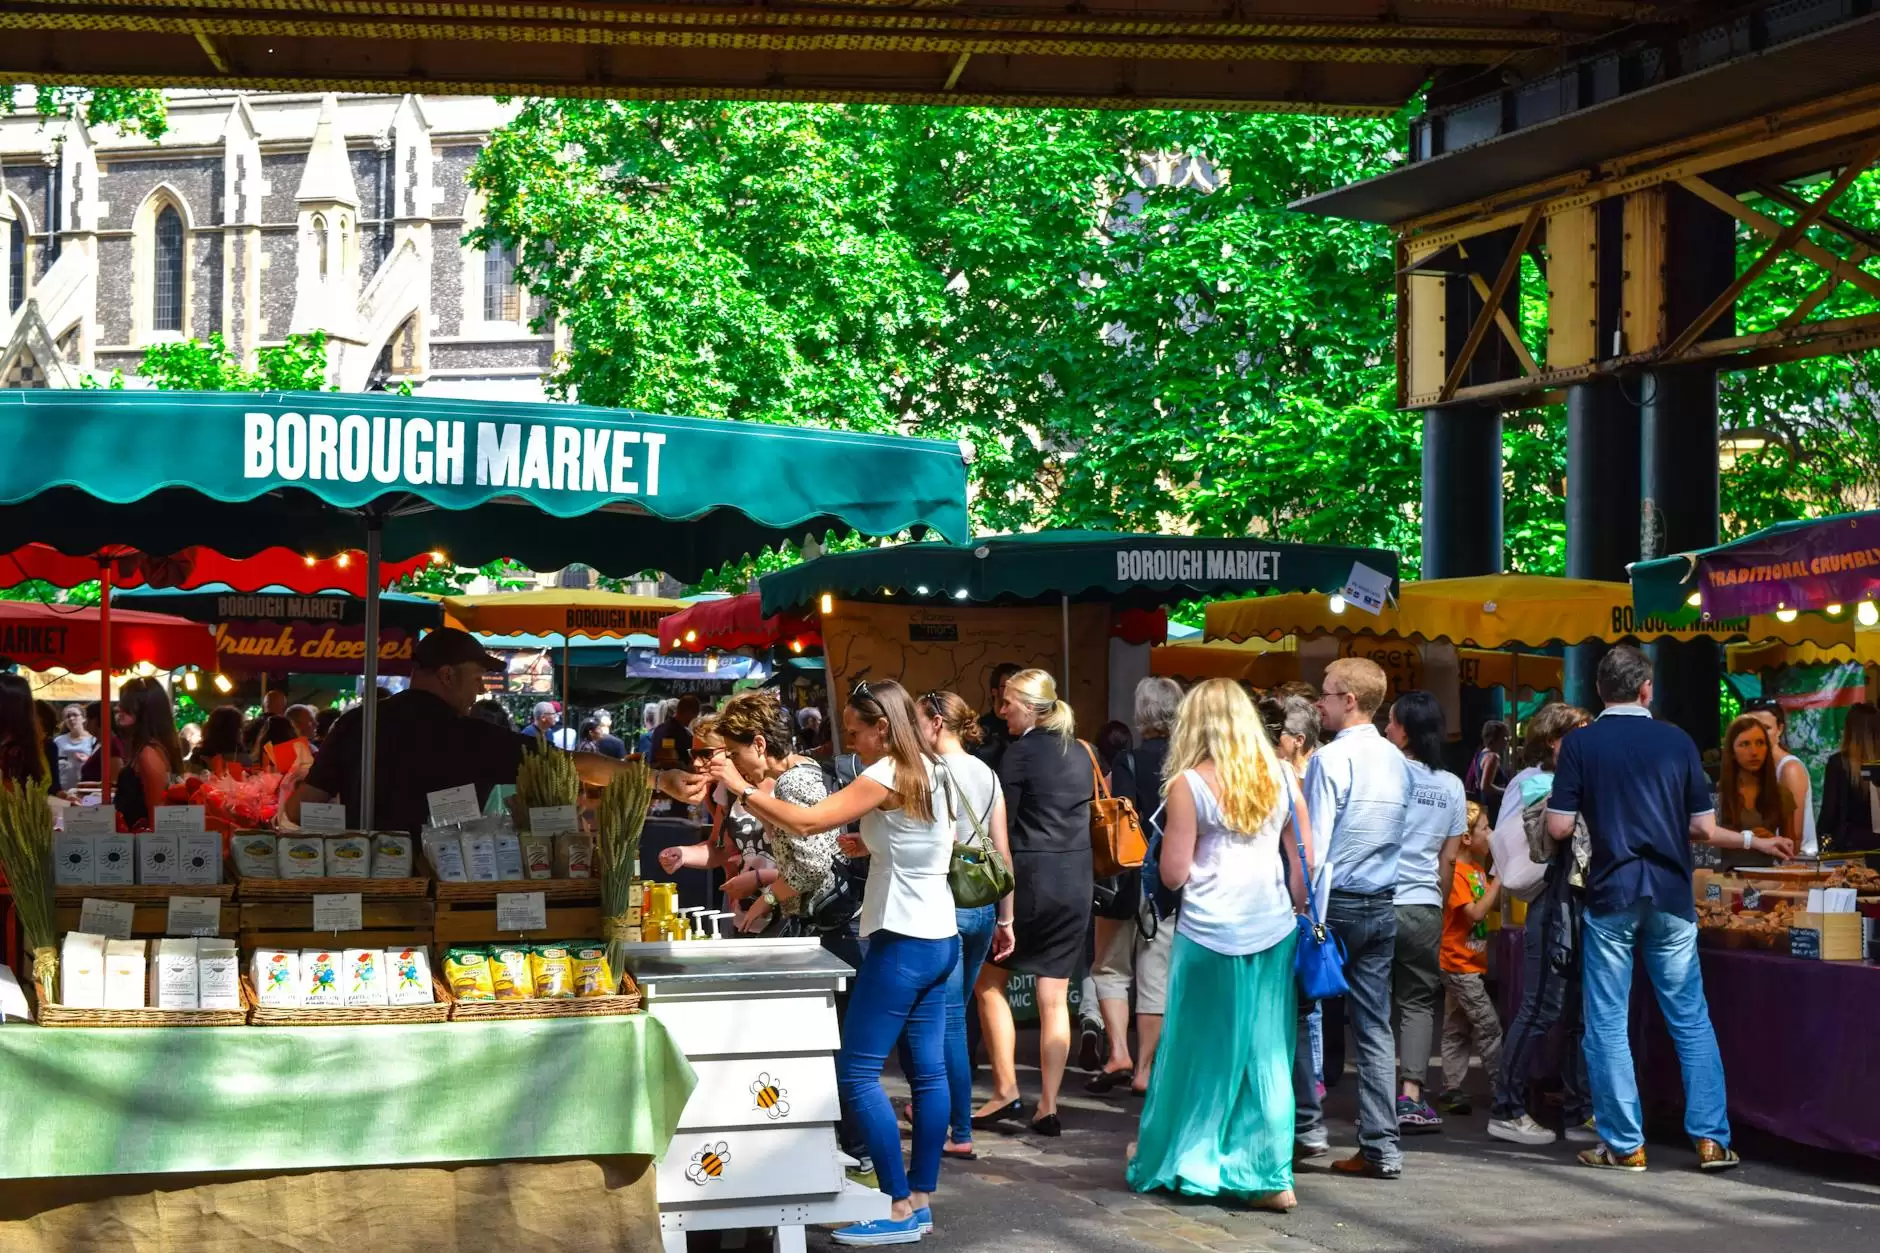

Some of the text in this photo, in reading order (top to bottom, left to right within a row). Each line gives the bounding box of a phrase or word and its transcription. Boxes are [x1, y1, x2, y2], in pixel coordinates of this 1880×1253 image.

[243, 412, 667, 496] BOROUGH MARKET
[1116, 550, 1281, 581] BOROUGH MARKET
[1708, 559, 1810, 588] TRADITIONAL
[217, 597, 347, 620] BOROUGH MARKET
[566, 608, 627, 629] BOROUGH
[0, 626, 68, 655] ARKET
[301, 628, 413, 659] cheees
[651, 653, 736, 668] pieminiter
